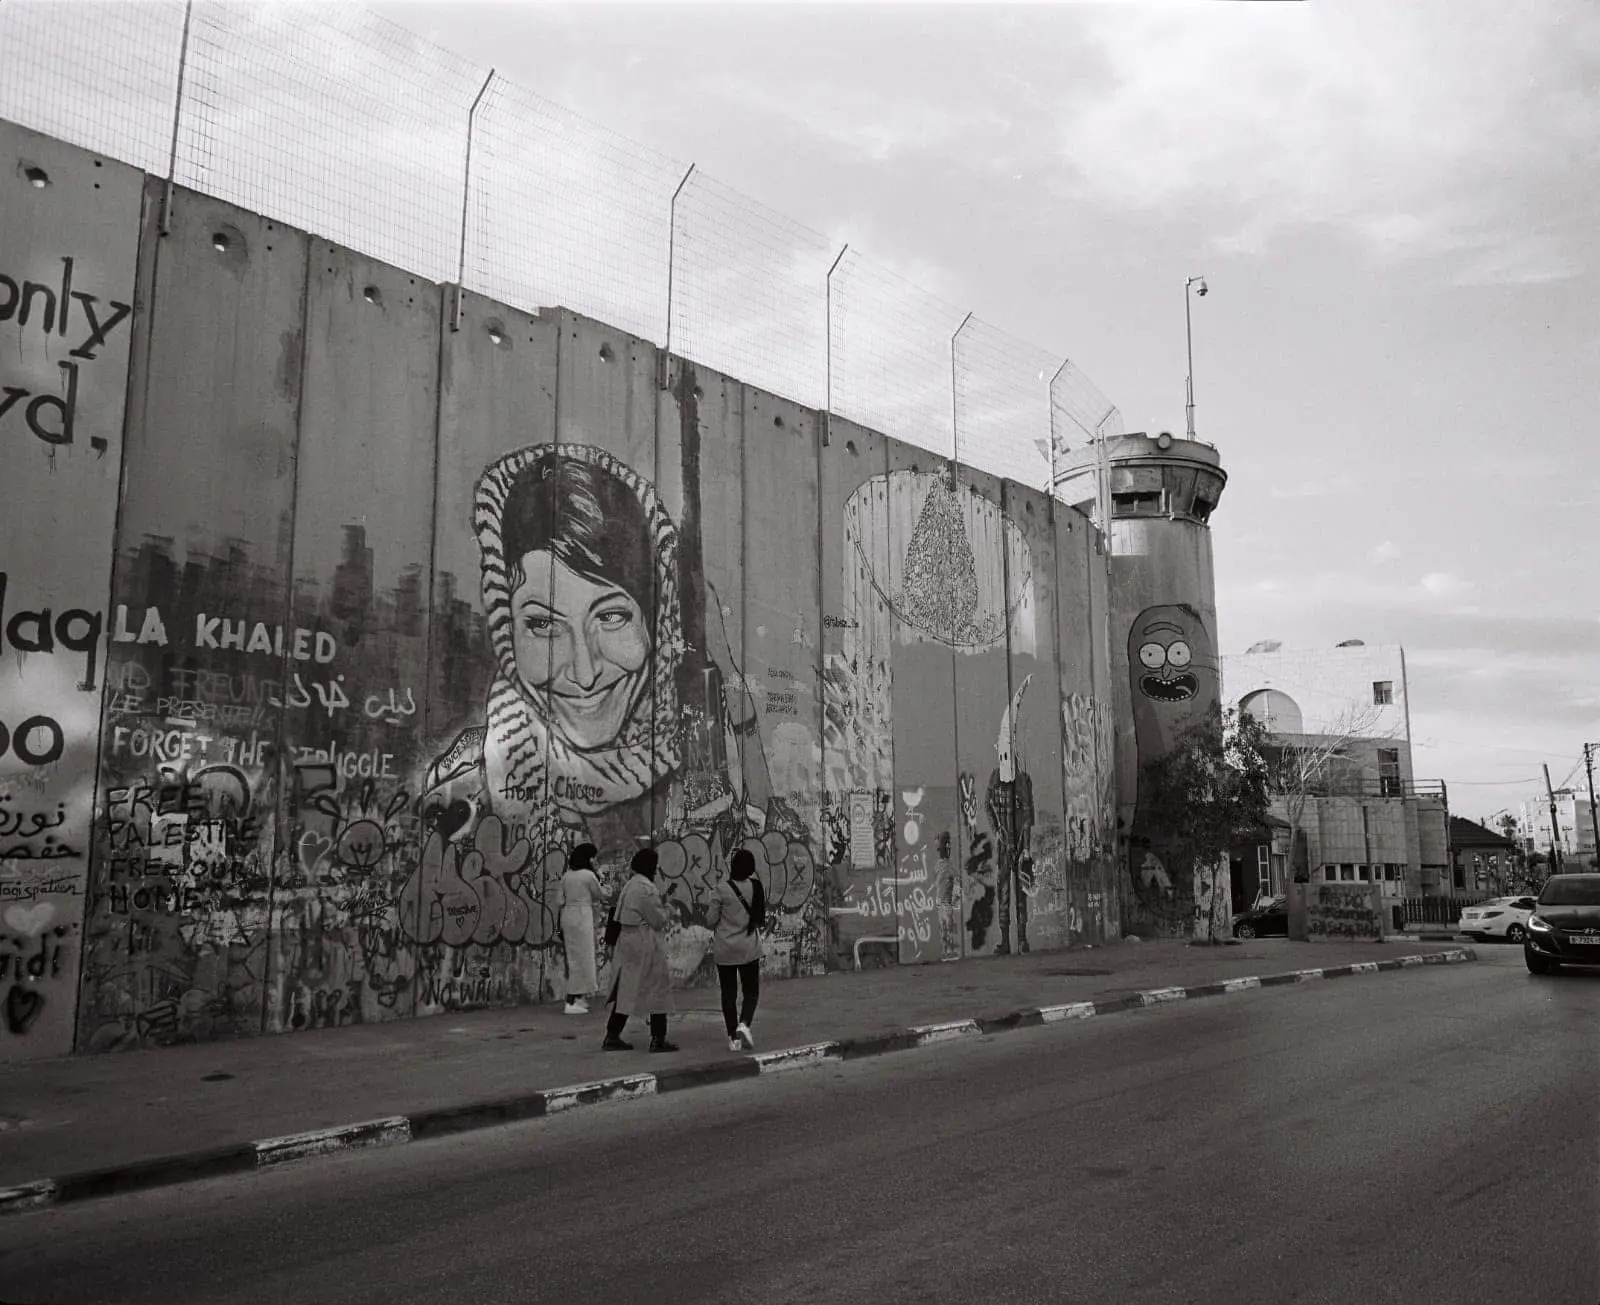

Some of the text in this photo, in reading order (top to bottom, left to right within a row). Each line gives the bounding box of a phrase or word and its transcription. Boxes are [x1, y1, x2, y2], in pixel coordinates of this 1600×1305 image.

[196, 613, 336, 664] KHALED
[0, 715, 65, 766] o
[113, 725, 402, 780] FORGET THE TUGGLE
[106, 785, 206, 818] FREE
